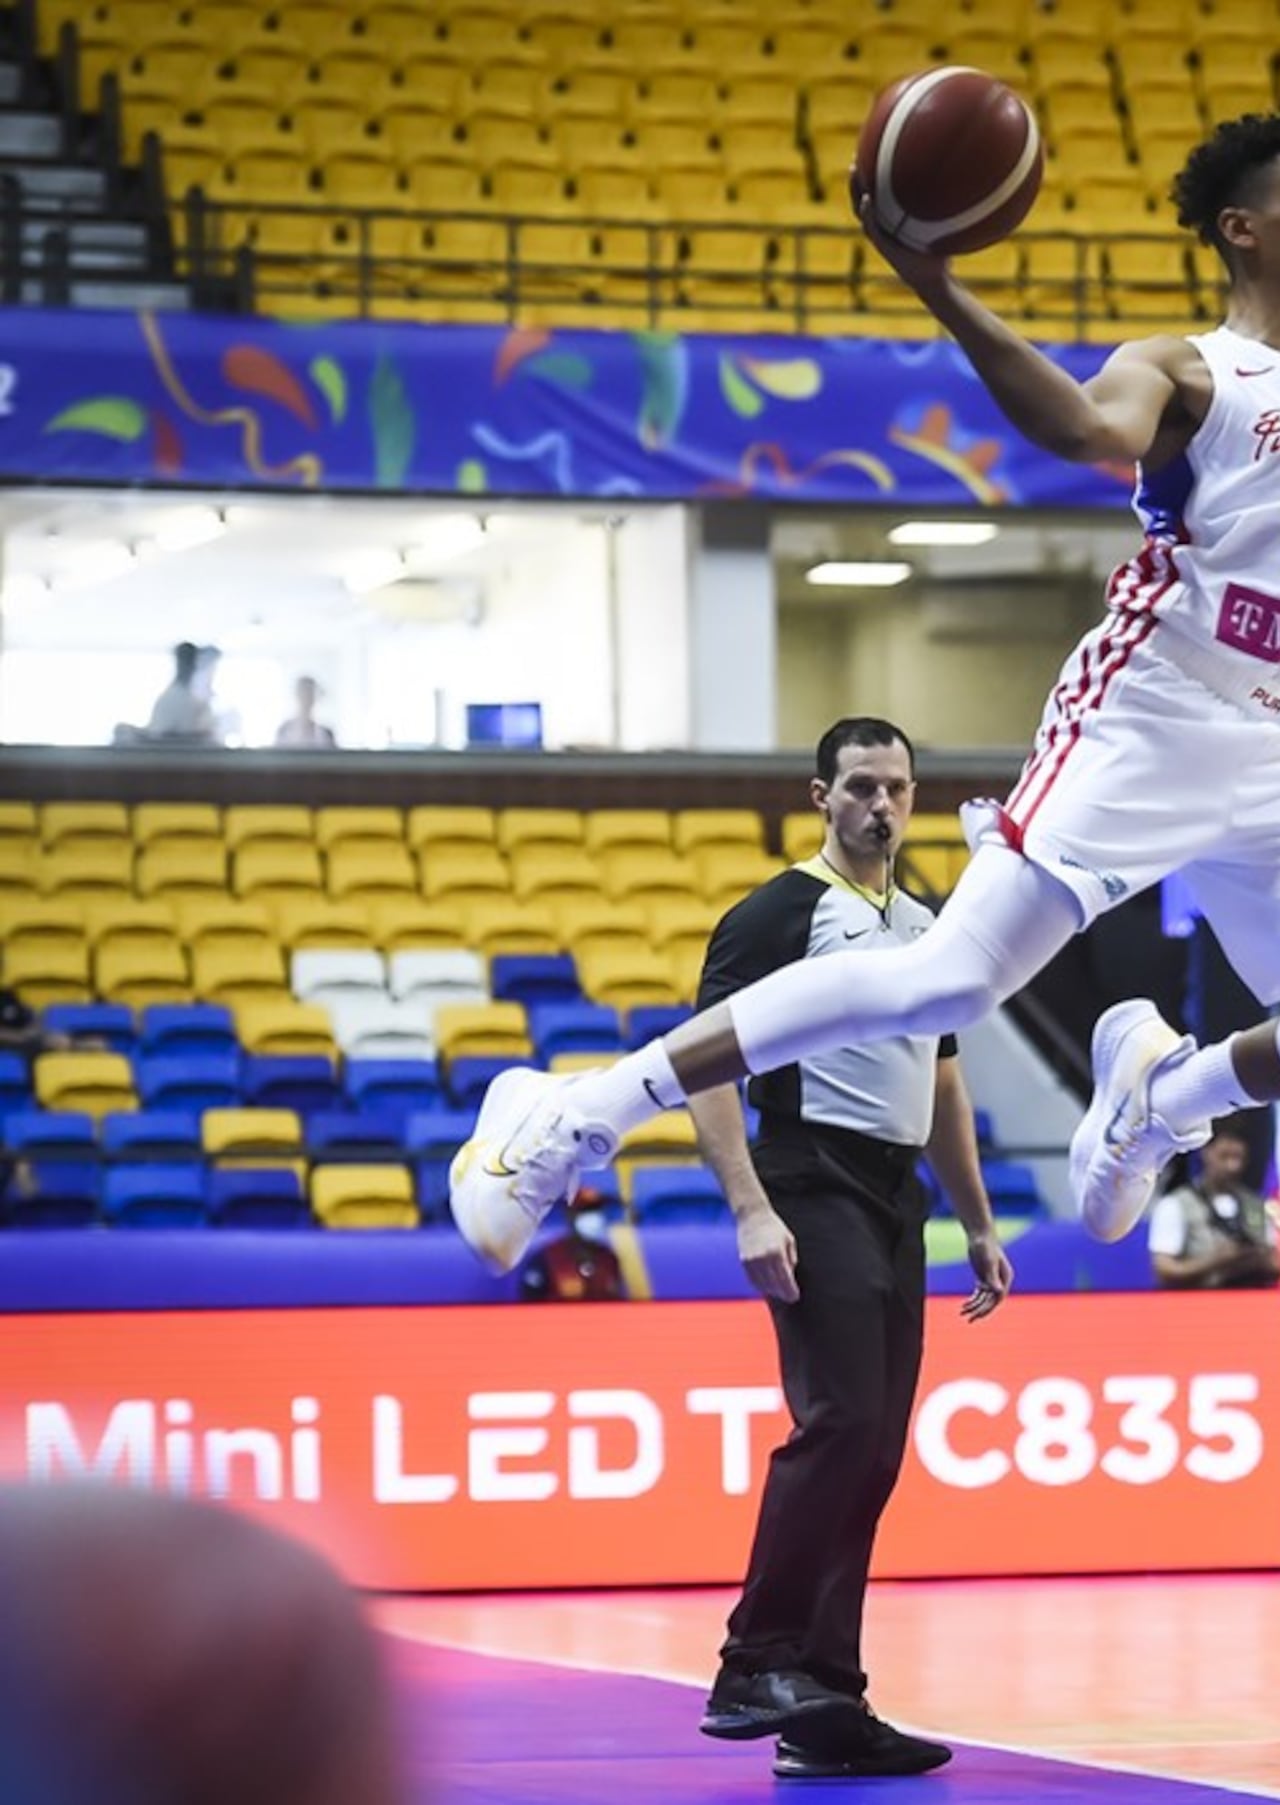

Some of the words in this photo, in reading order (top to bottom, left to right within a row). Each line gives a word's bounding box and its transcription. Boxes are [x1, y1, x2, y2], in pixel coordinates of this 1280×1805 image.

[26, 1396, 320, 1501] Mini
[373, 1393, 664, 1503] LED
[686, 1386, 782, 1495] T
[914, 1374, 1265, 1489] C835
